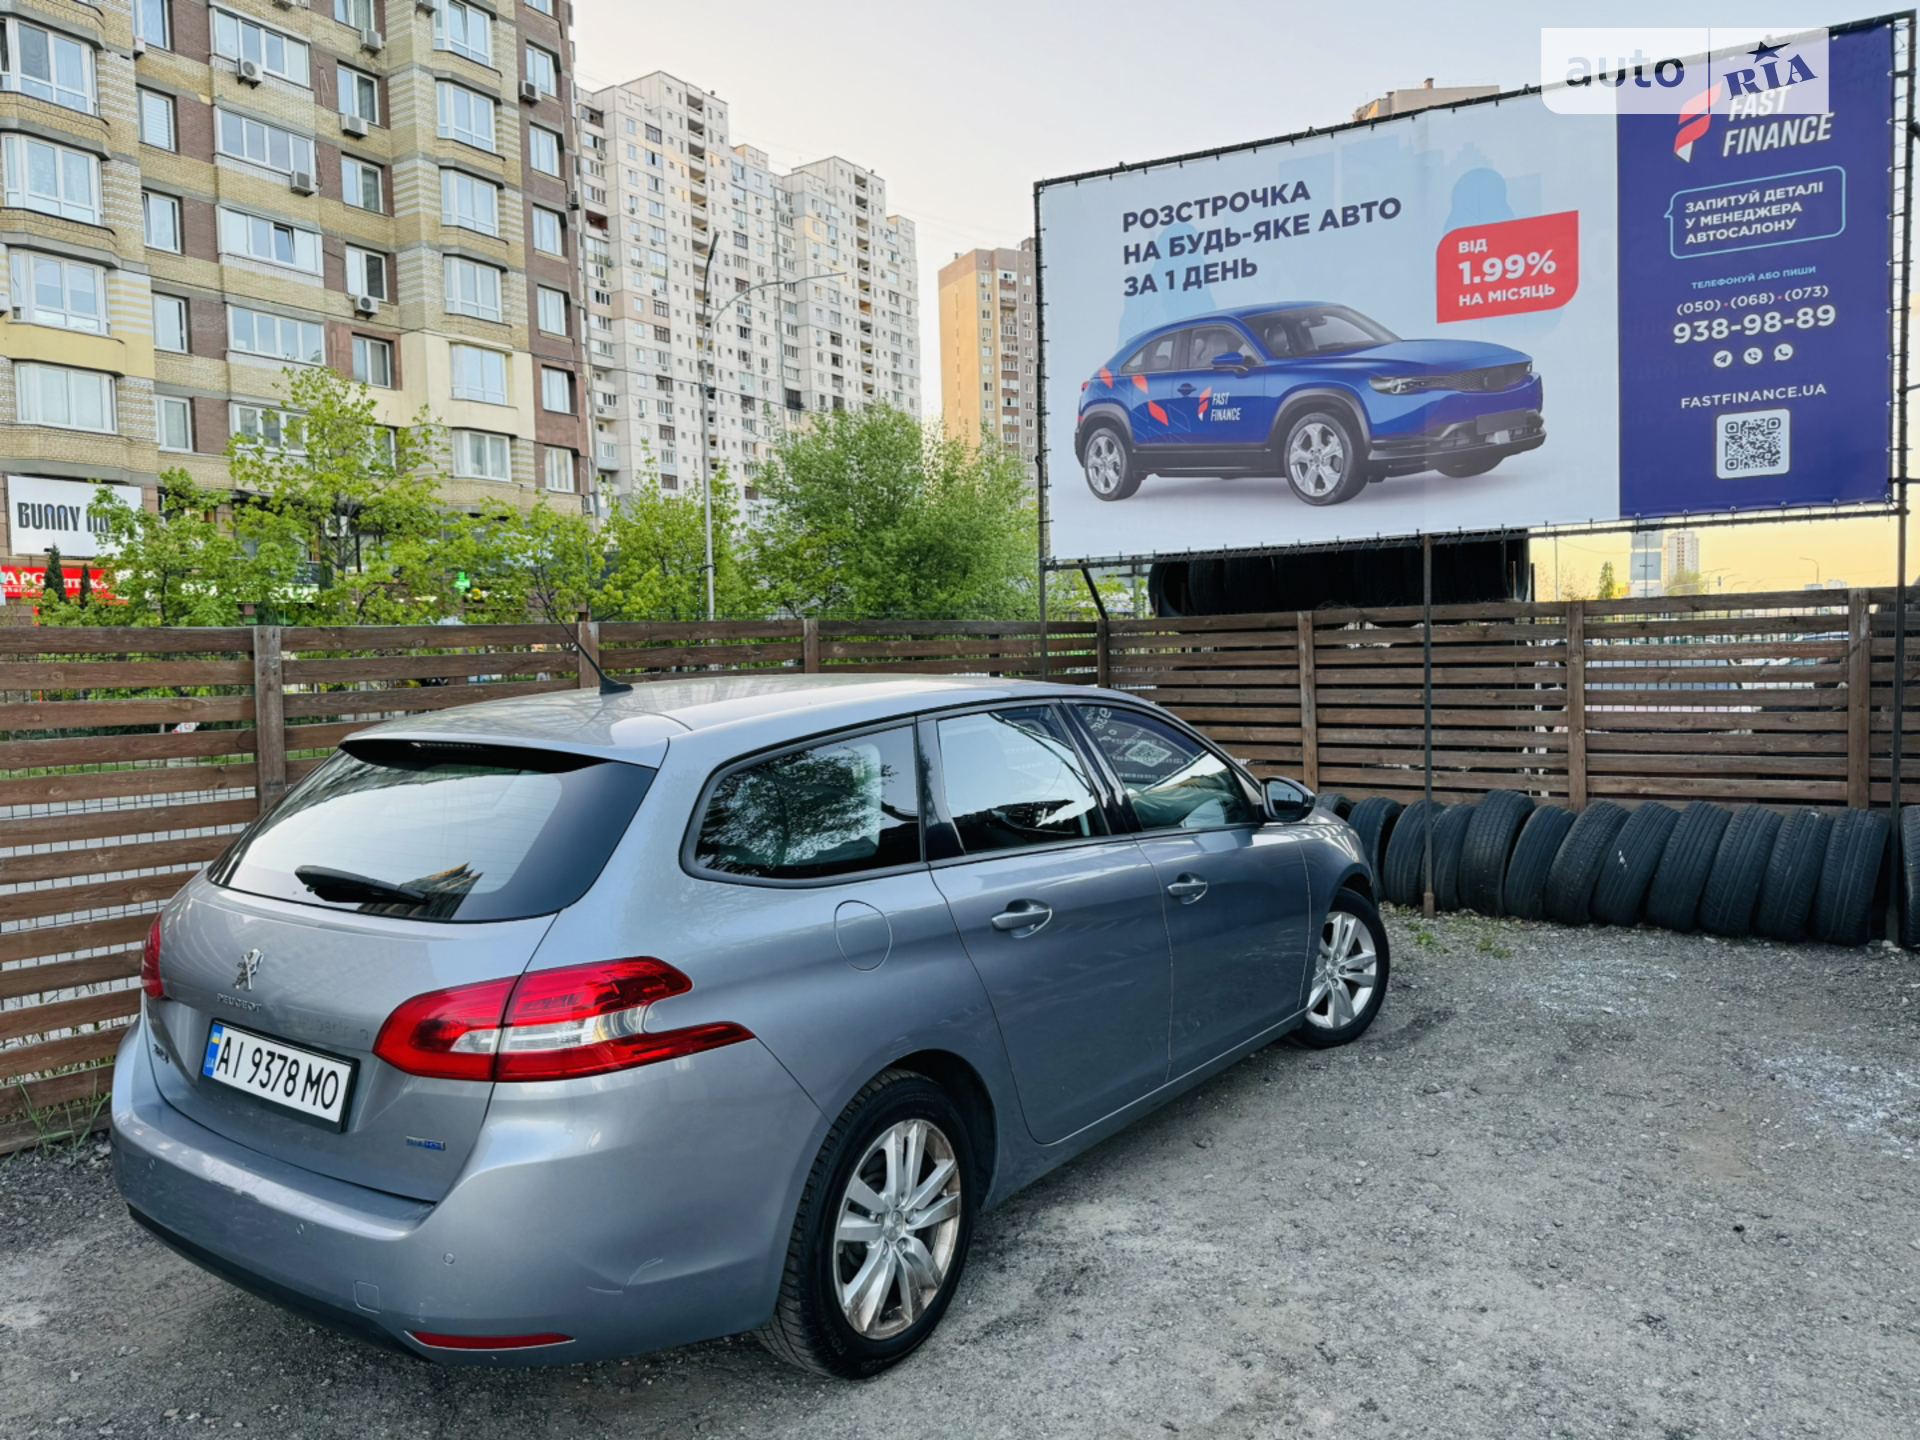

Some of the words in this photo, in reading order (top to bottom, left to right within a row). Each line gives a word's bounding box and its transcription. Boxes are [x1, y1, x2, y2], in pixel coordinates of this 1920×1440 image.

[1728, 85, 1792, 122] FAST
[1722, 112, 1835, 158] FINANCE
[1123, 181, 1311, 232] РОЗСТРОЧКА
[1685, 190, 1760, 213] ЗАПИТУЙ
[1764, 181, 1823, 203] ДЕТАЛІ
[1685, 217, 1696, 229] У
[1700, 201, 1803, 228] МЕНЕДЖЕРА
[1124, 240, 1161, 265] НА
[1169, 213, 1310, 258] БУДЬ-ЯКЕ
[1318, 197, 1402, 232] АВТО
[1458, 238, 1487, 254] ВІД
[1685, 218, 1797, 245] АВТОСАЛОНУ
[1124, 274, 1158, 297] ЗА
[1165, 270, 1175, 290] 1
[1182, 257, 1258, 291] ДЕНЬ
[1458, 249, 1557, 285] 1.99%
[1691, 272, 1755, 289] ТЕЛЕФОНУЙ
[1758, 270, 1780, 281] АБО
[1783, 265, 1817, 278] ПИШИ
[1459, 292, 1484, 307] НА
[1488, 283, 1556, 303] МІСЯЦЬ
[1676, 299, 1721, 316] (050)
[1730, 292, 1775, 309] (068)
[1784, 285, 1829, 302] (073)
[1673, 304, 1836, 344] 938-98-89
[1212, 392, 1230, 406] FAST
[1681, 383, 1827, 409] FASTFINANCE.UA
[1210, 408, 1242, 422] FINANCE
[17, 502, 81, 531] BUNNY
[215, 1036, 244, 1079] AI
[247, 1047, 300, 1098] 9378
[301, 1063, 339, 1110] MO
